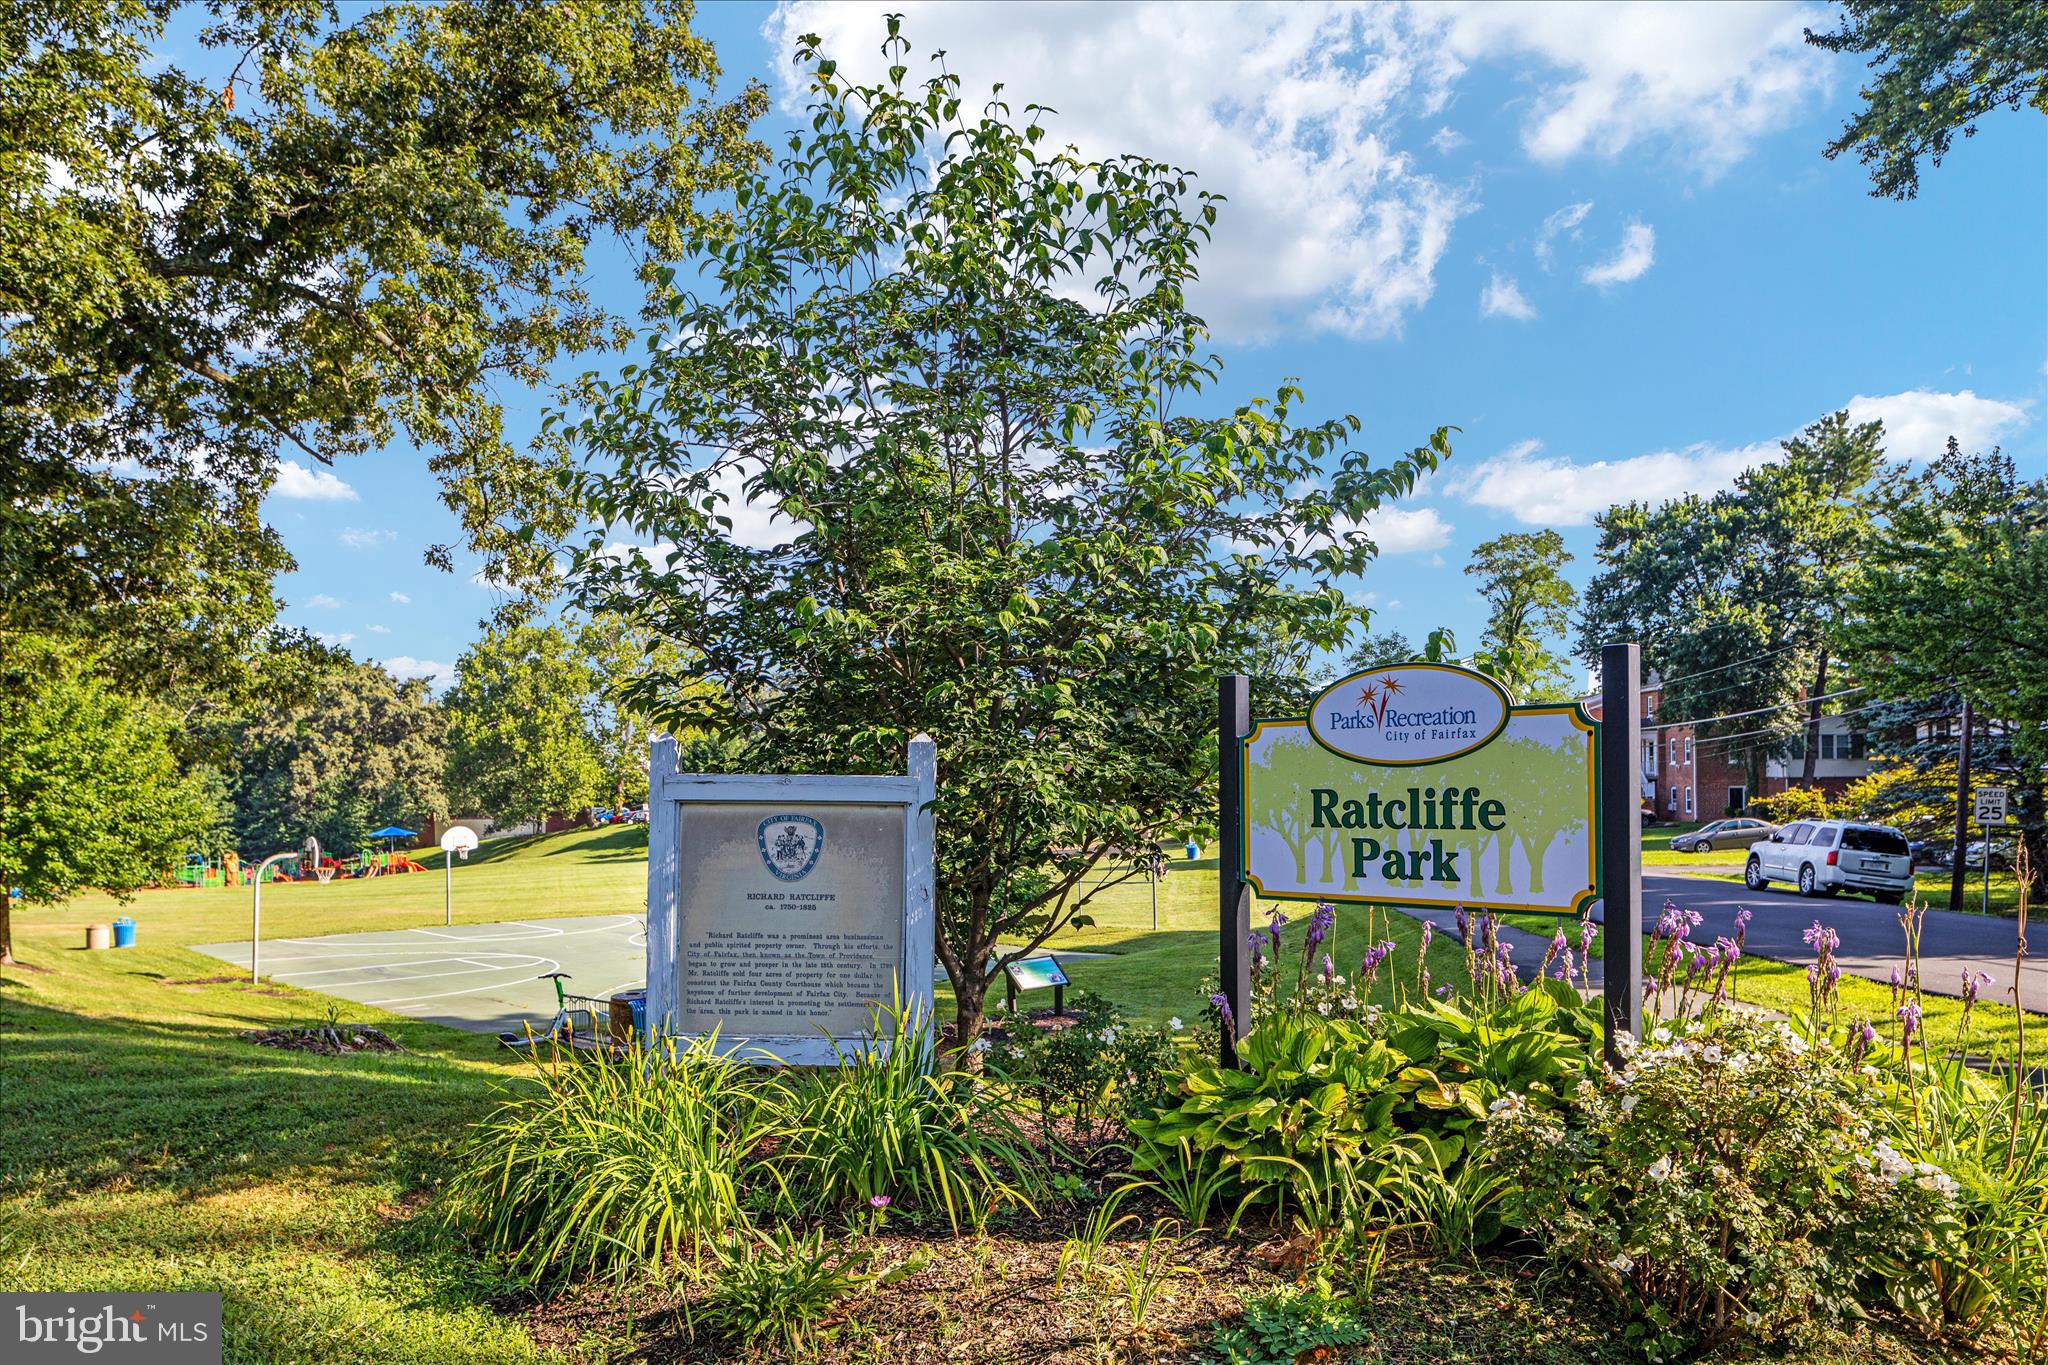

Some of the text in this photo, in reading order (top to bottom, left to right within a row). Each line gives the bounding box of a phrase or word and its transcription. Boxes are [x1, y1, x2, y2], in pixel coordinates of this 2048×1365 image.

[1330, 707, 1477, 730] Parks Recreation
[1385, 727, 1477, 743] City of Fairfax
[1978, 790, 2005, 798] SPEED
[1310, 787, 1507, 831] Ratcliffe
[1978, 806, 2002, 820] 25
[1351, 837, 1461, 882] Park
[775, 869, 807, 880] VIRGINIA
[789, 893, 836, 901] RATCLIFFE
[790, 933, 823, 941] prominent
[843, 933, 884, 941] businessman
[726, 942, 751, 950] spirited
[813, 942, 840, 951] Through
[687, 951, 701, 959] City
[808, 952, 825, 960] Town
[688, 961, 707, 969] began
[754, 962, 779, 970] prosper
[836, 962, 863, 970] century.
[760, 980, 783, 988] County
[785, 980, 822, 988] Courthouse
[846, 981, 870, 989] became
[686, 989, 715, 997] keystone
[754, 990, 793, 998] development
[833, 990, 849, 999] City.
[787, 1000, 821, 1008] promoting
[734, 1008, 749, 1016] park
